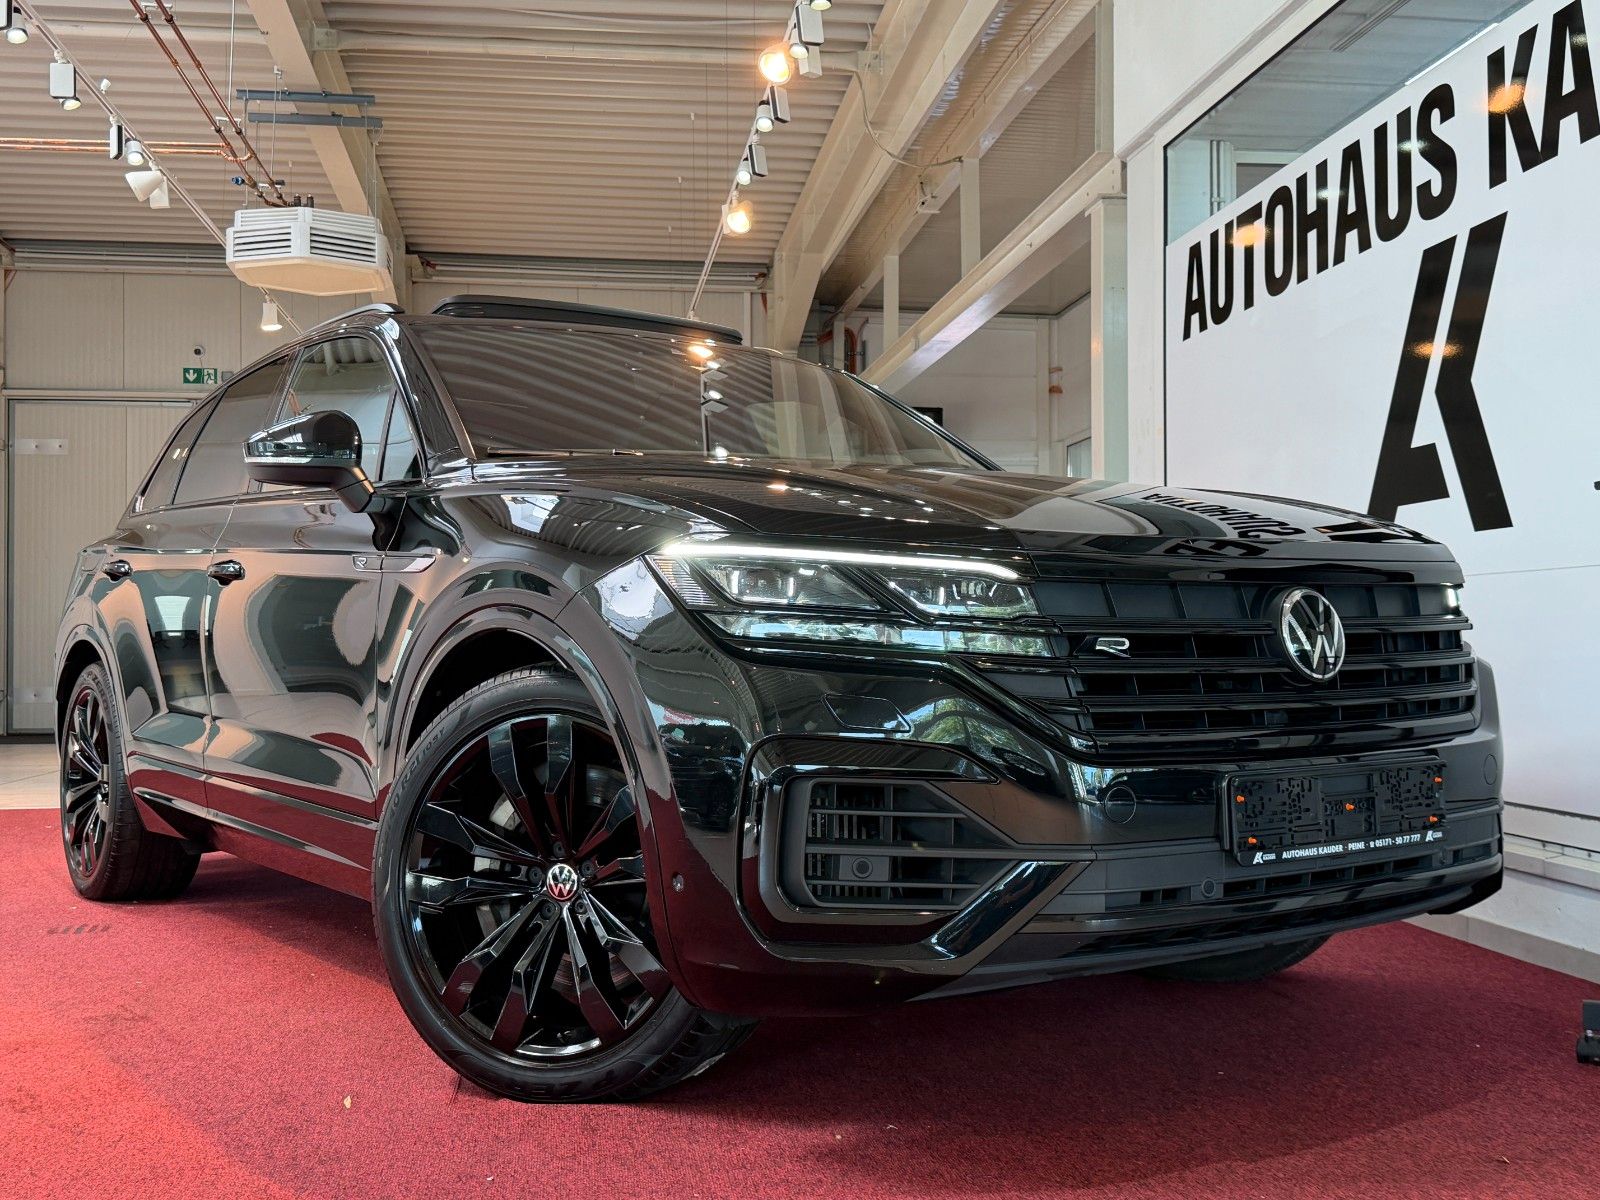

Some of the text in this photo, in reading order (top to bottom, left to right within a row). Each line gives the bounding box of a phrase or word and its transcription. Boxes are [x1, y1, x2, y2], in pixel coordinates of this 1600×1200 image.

[1183, 83, 1457, 341] AUTOHAUS
[1282, 848, 1318, 859] AUTOHAUS
[1319, 844, 1343, 855] KAUDER
[1348, 841, 1365, 850] PEINE
